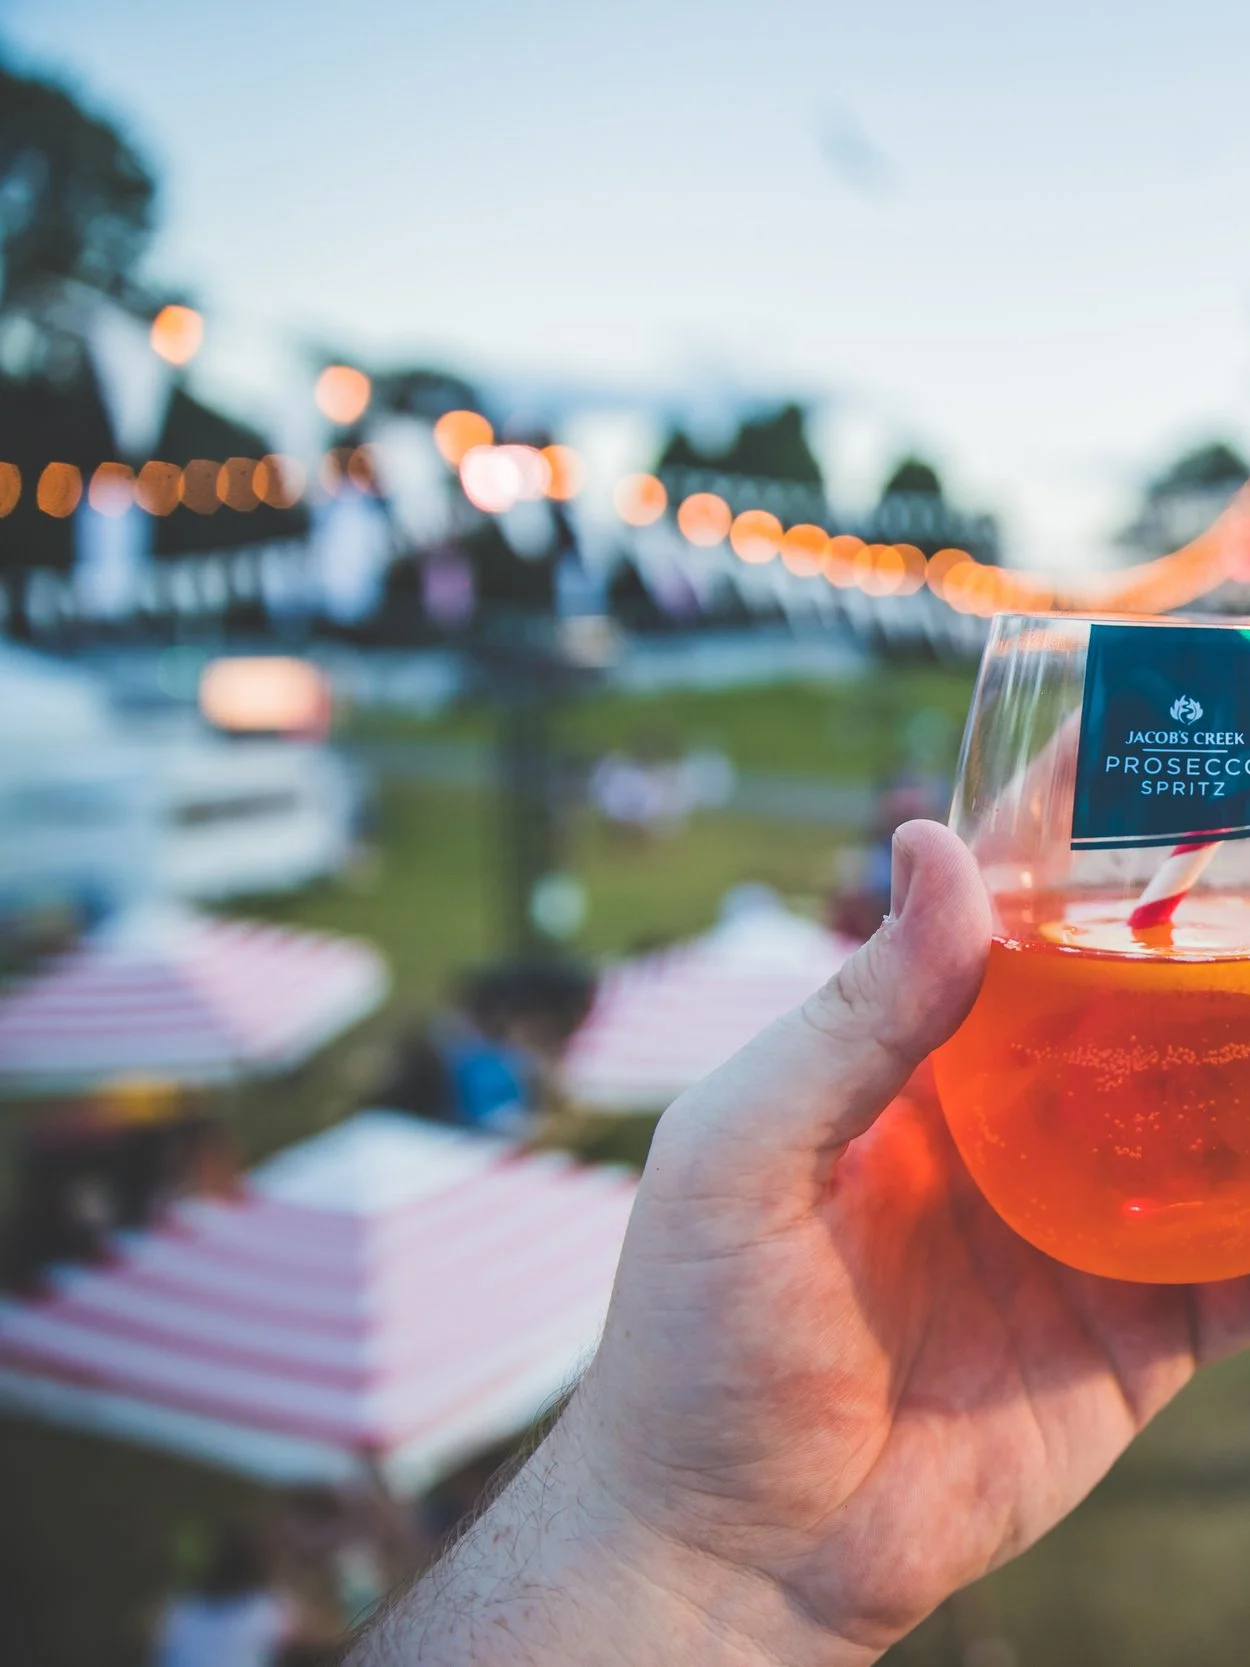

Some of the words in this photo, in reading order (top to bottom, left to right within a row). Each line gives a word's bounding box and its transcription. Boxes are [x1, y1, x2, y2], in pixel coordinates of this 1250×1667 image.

[1125, 730, 1189, 745] JACOB'S
[1193, 732, 1245, 745] CREEK
[1141, 780, 1225, 796] SPRITZ
